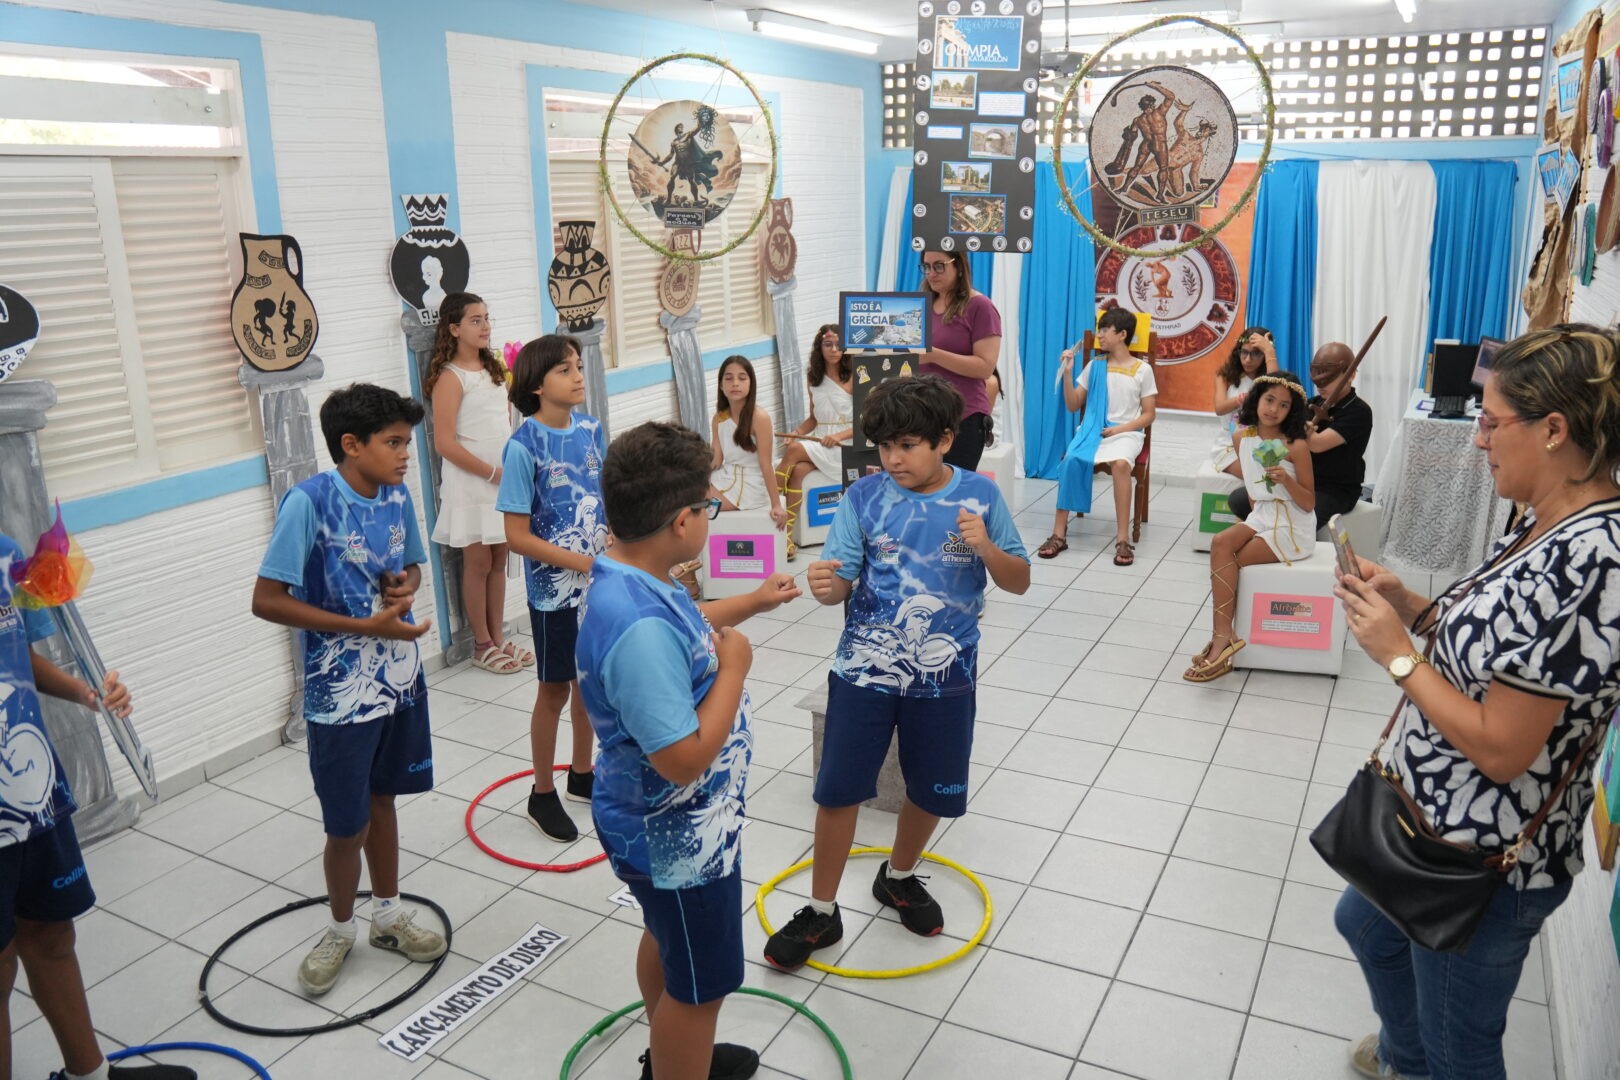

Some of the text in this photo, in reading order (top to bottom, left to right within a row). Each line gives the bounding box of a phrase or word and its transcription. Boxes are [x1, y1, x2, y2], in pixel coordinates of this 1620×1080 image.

[945, 43, 1002, 58] OLIMPIA
[1146, 207, 1188, 220] TESEU
[851, 301, 882, 311] ISTO É A
[851, 312, 889, 325] GRÉCIA
[387, 929, 562, 1057] LANÇAMENTO DE DISCO
